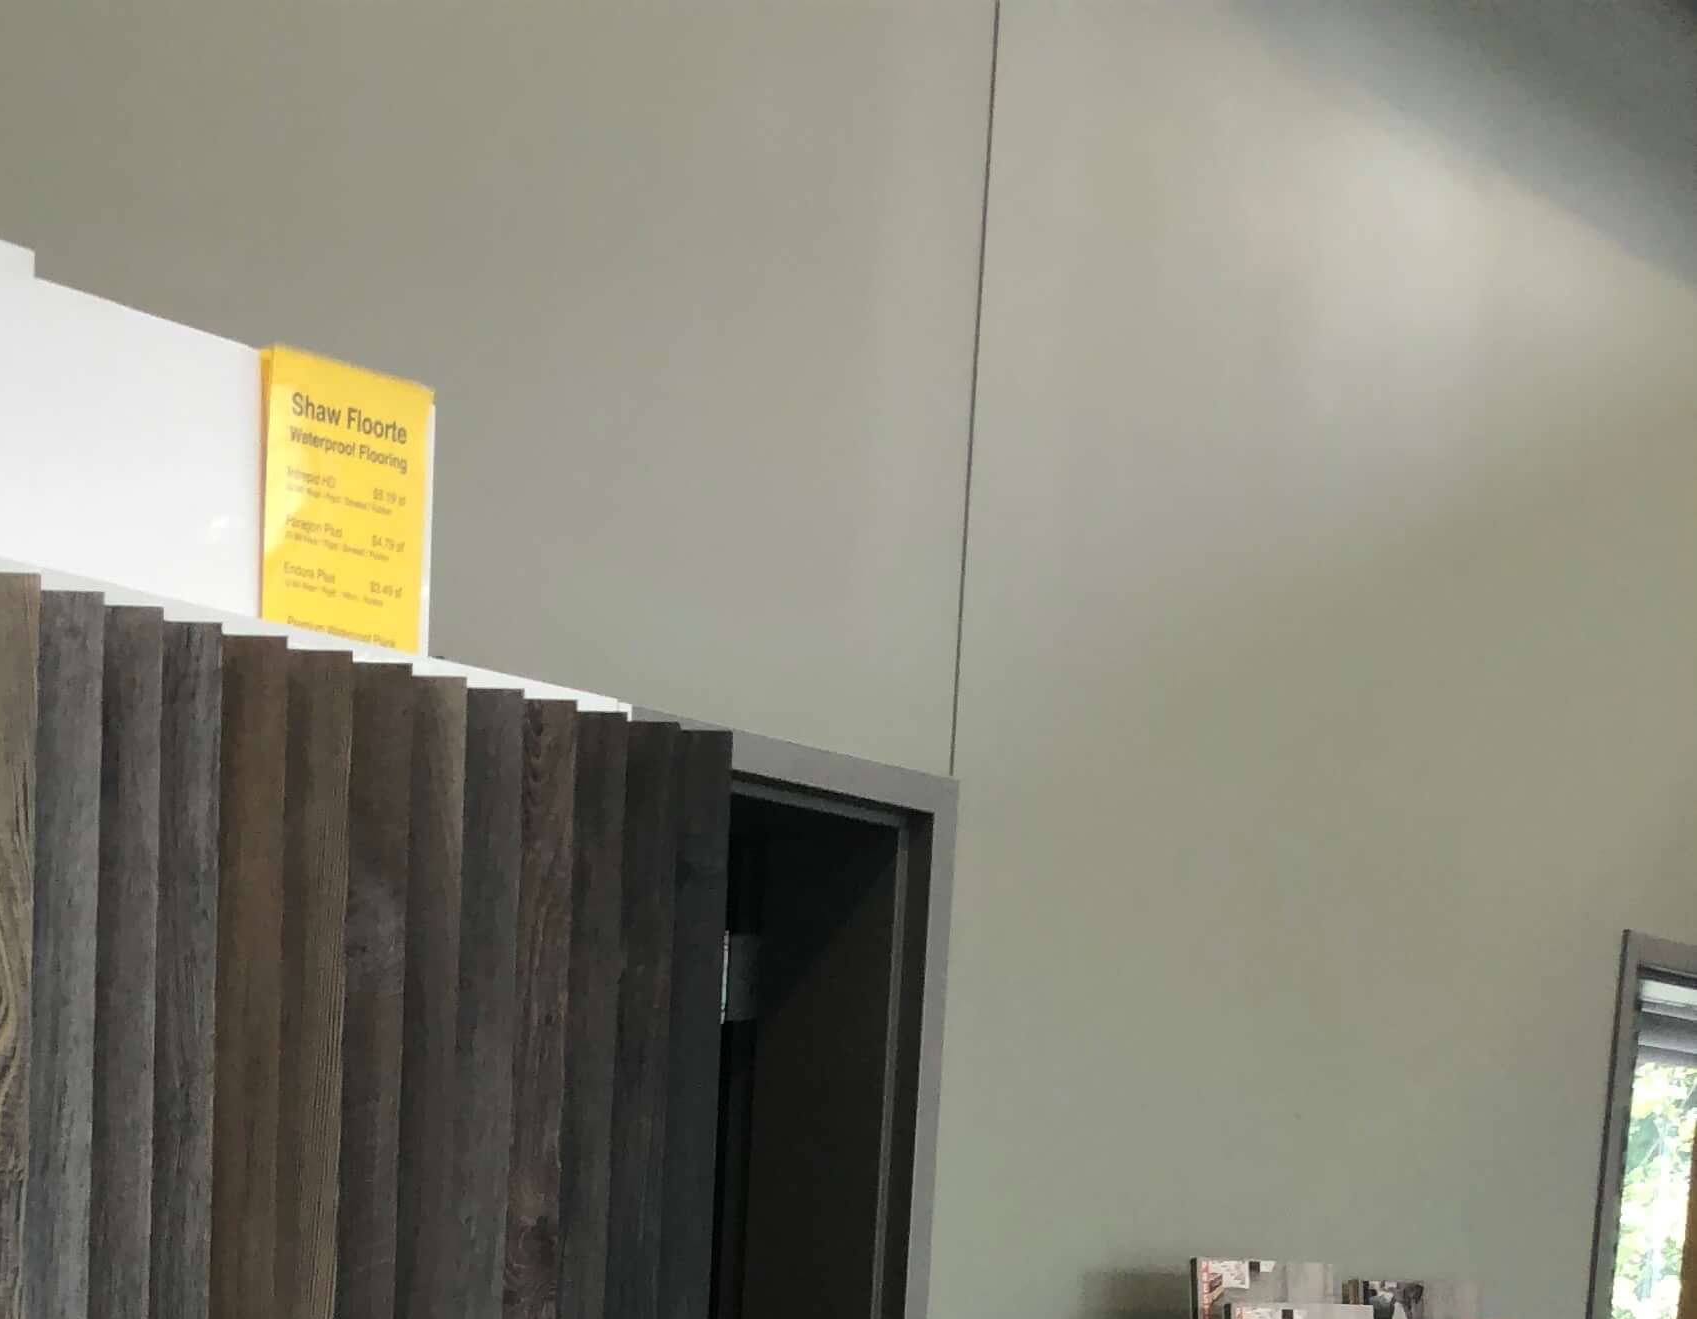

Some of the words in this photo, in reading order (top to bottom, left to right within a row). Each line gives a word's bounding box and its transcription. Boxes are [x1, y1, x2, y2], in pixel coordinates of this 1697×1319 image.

[292, 391, 341, 426] Shaw
[347, 407, 407, 444] Floorte
[359, 444, 407, 474] Flooring
